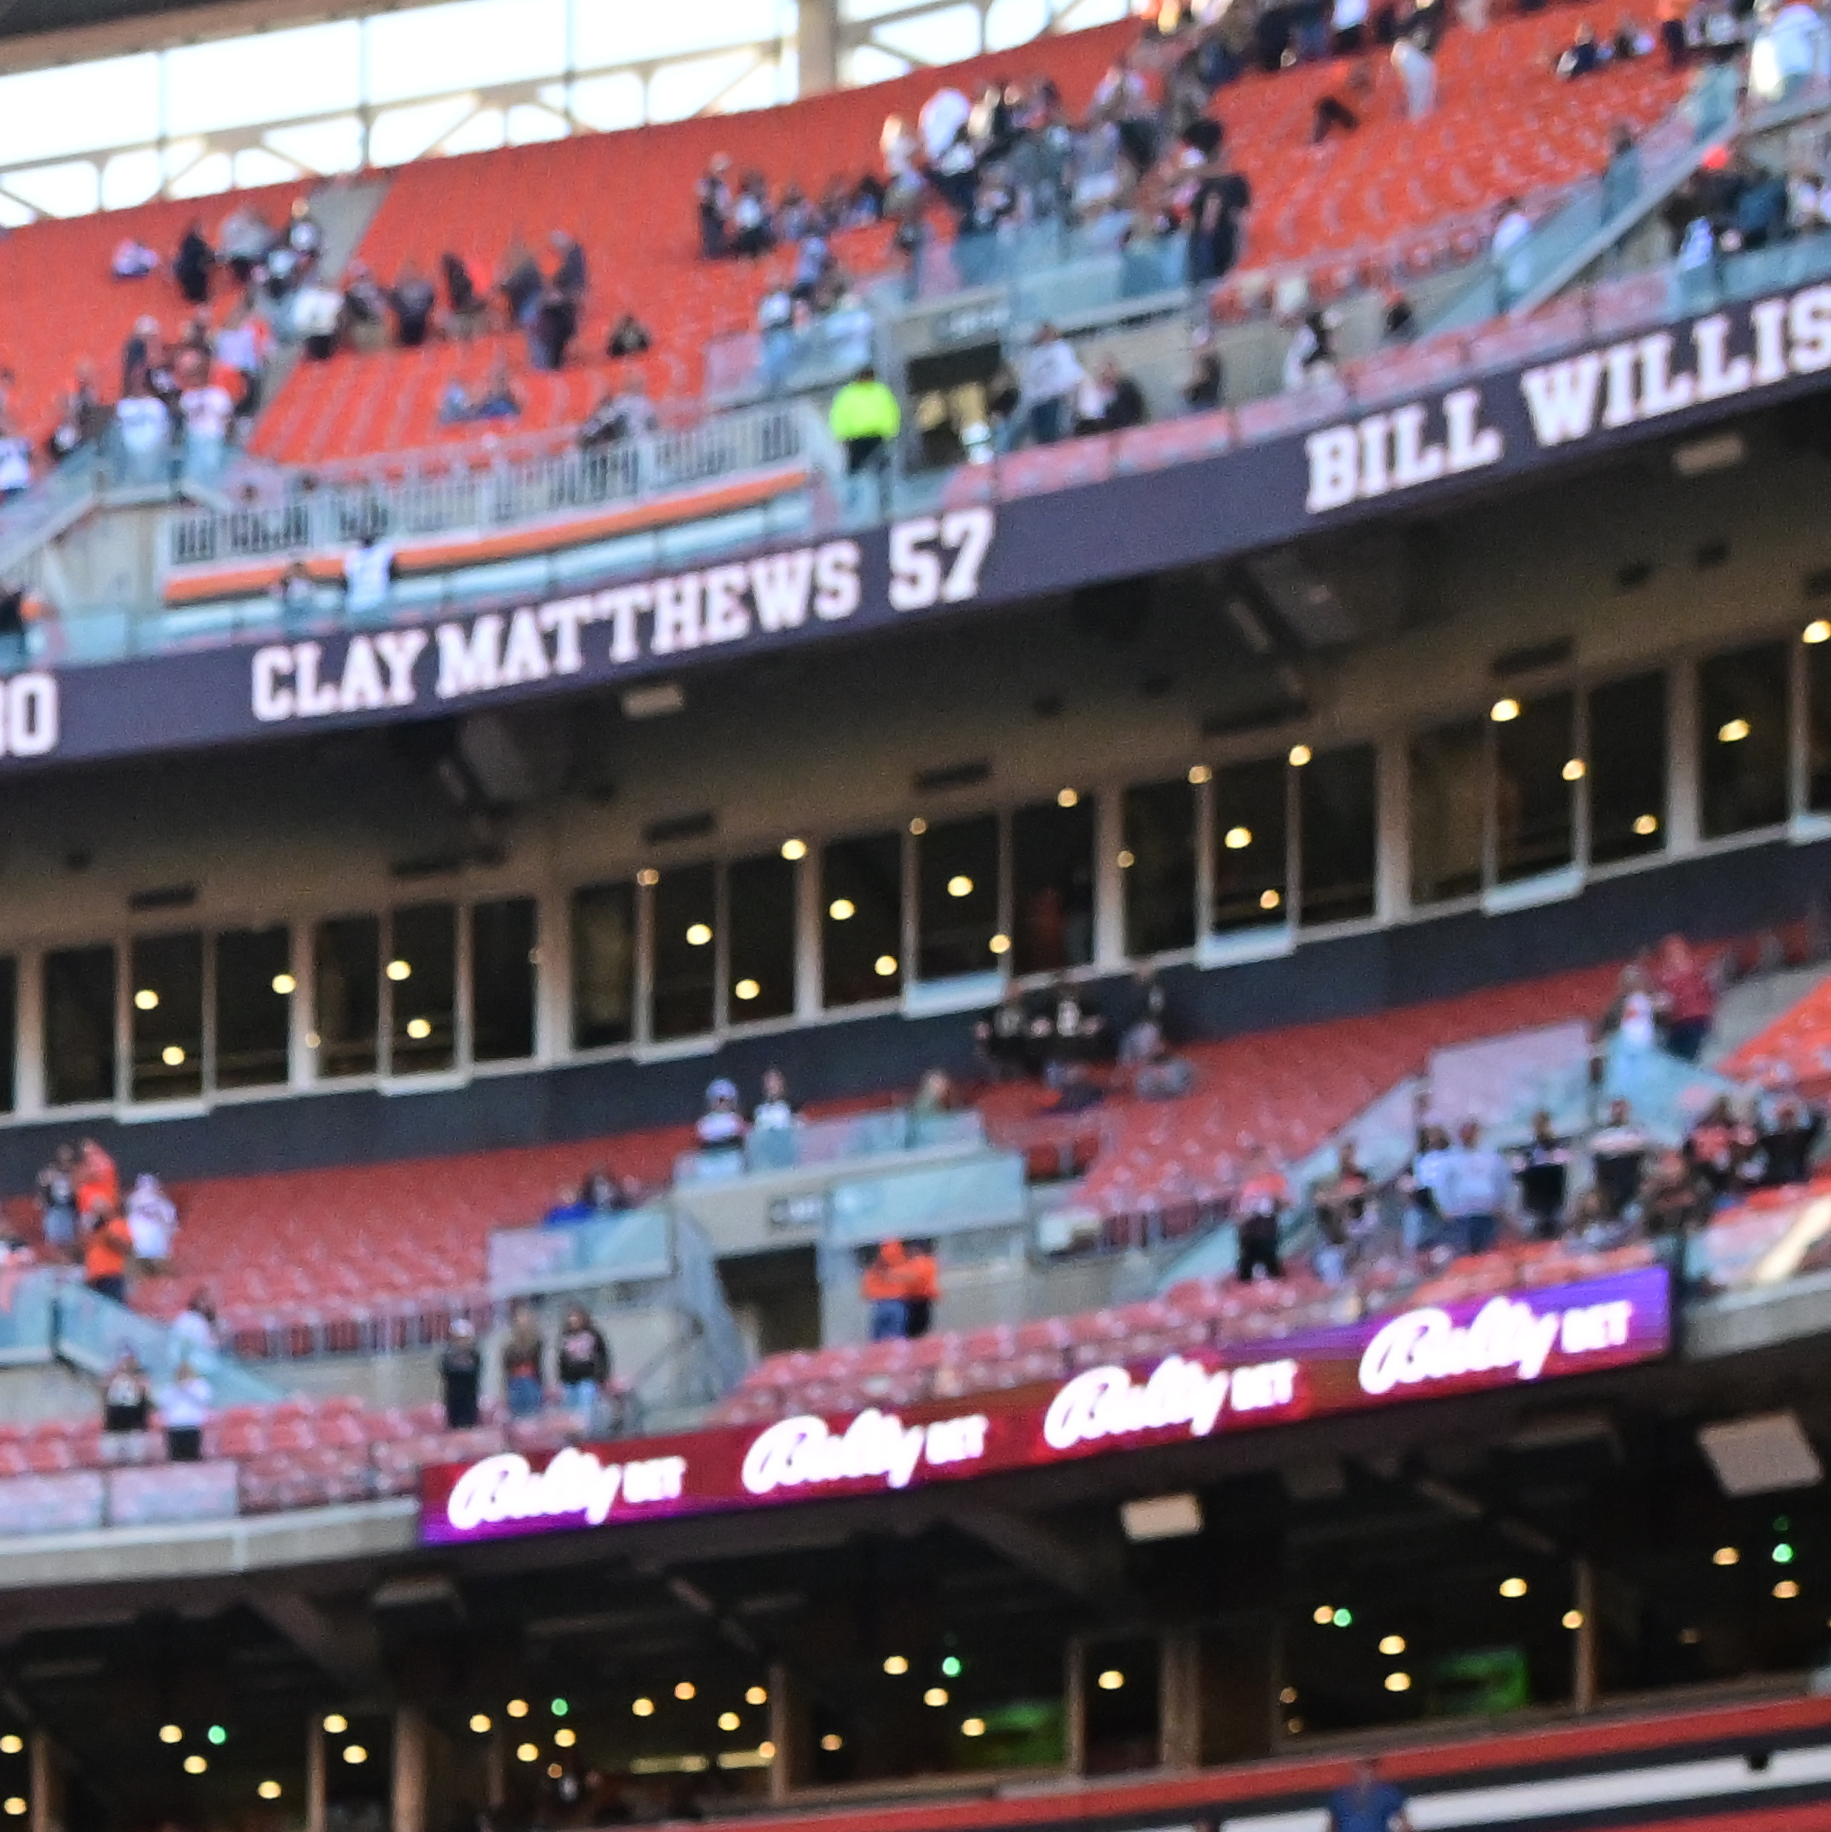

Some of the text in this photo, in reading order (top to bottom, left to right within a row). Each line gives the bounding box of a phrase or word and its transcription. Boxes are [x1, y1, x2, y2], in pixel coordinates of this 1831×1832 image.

[1304, 283, 1831, 514] BILL WILLIS
[250, 507, 996, 722] CLAY MATTHEWS 57
[1359, 1295, 1560, 1395] Bally
[1043, 1354, 1230, 1449] Bally
[446, 1446, 622, 1530] Bally
[741, 1407, 925, 1494] Bally
